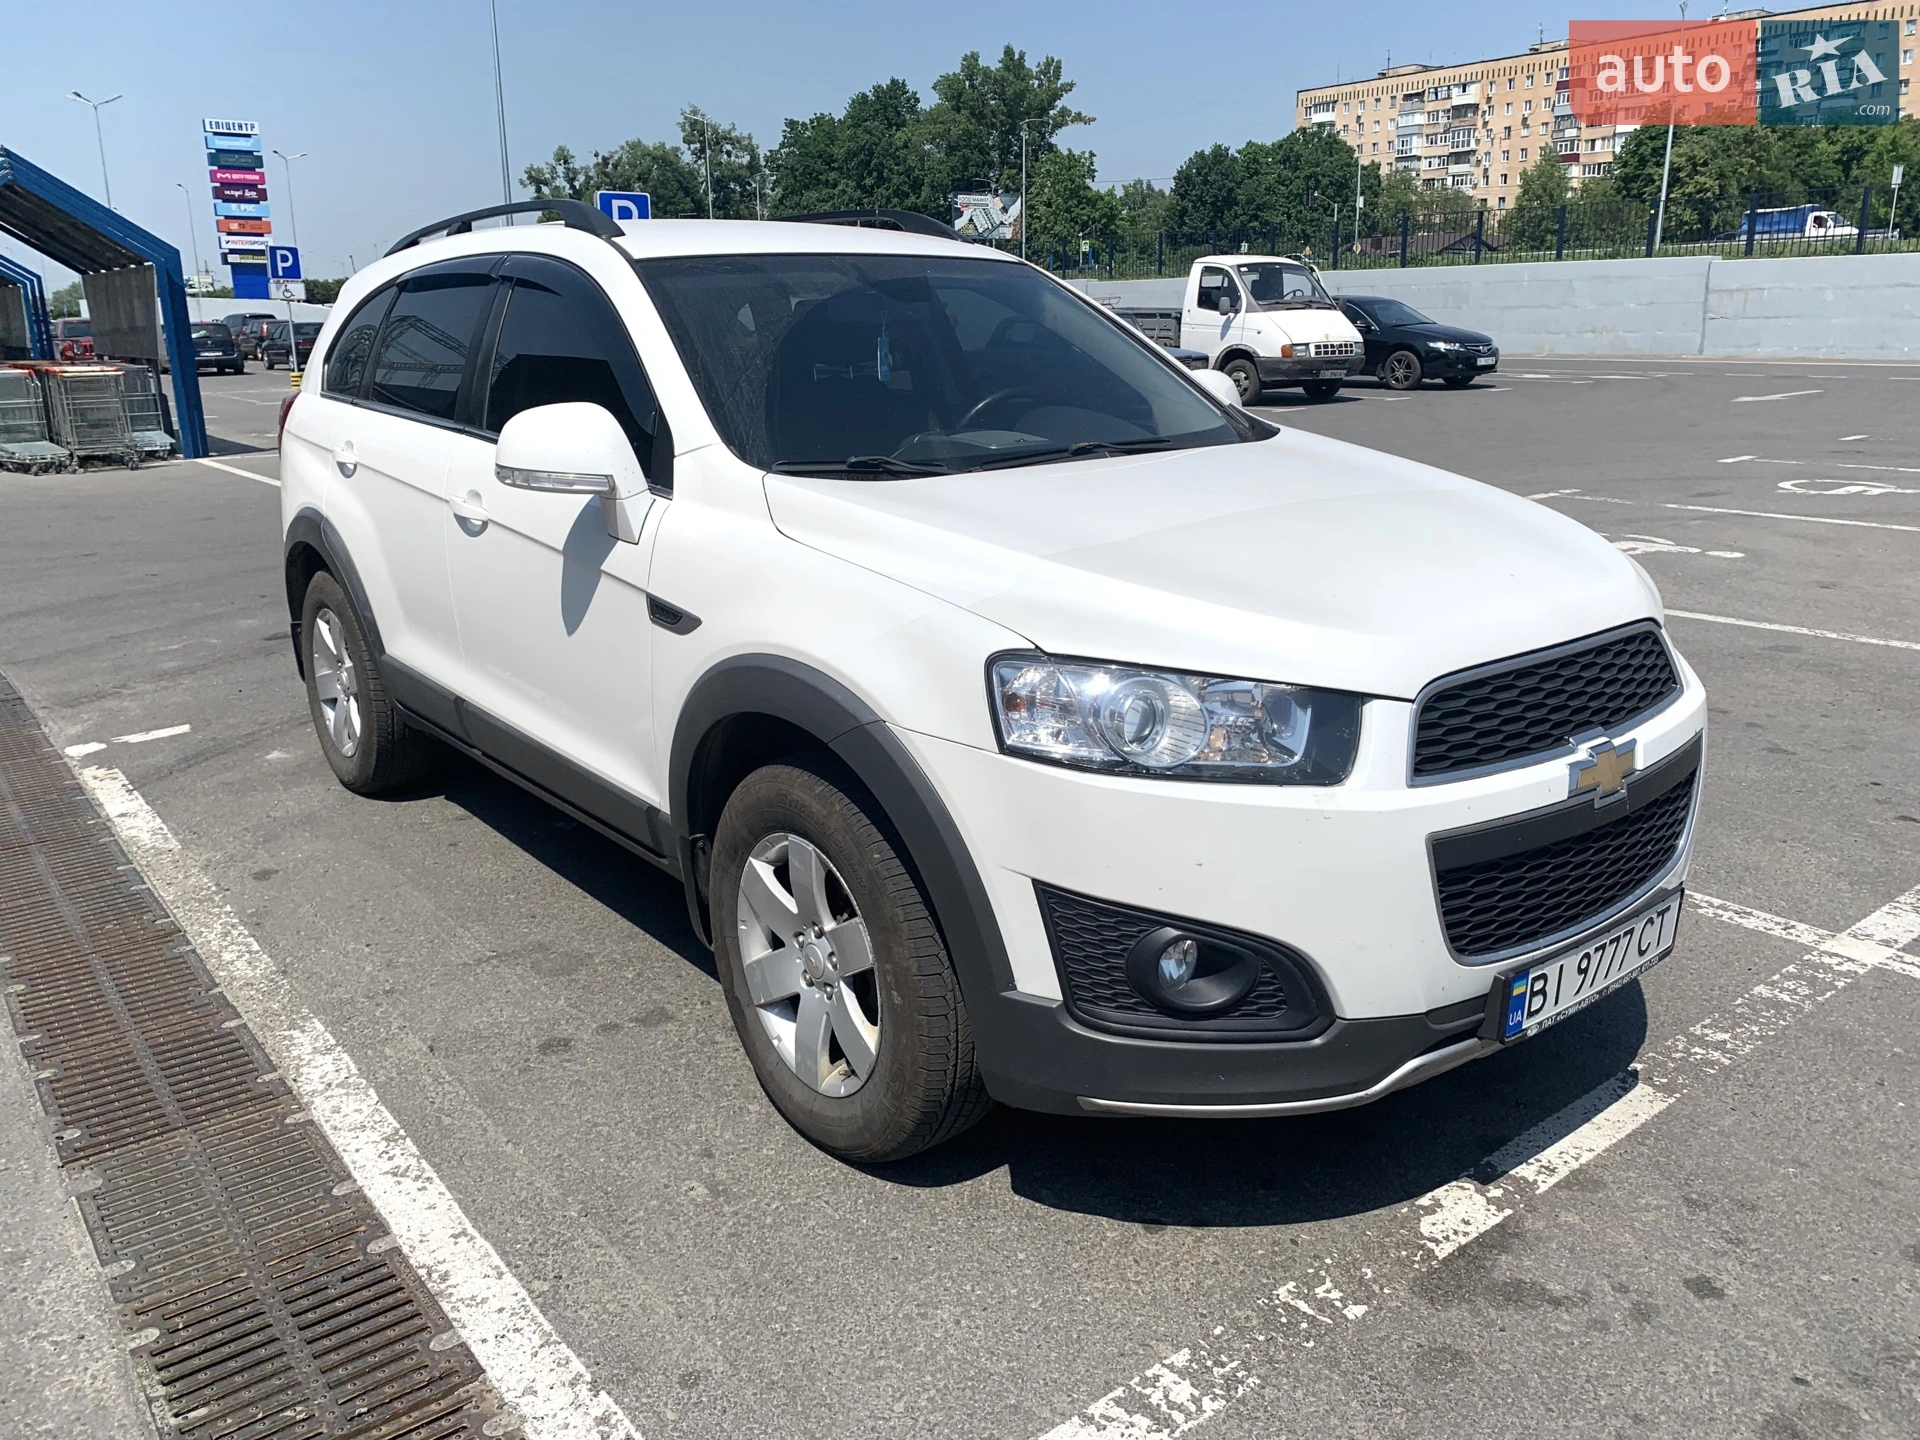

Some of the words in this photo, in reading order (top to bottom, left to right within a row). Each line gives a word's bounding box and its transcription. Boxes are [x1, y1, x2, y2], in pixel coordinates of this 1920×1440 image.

[208, 120, 256, 132] ЕПІЦЕНТР
[275, 249, 294, 277] P
[1573, 926, 1636, 996] 9777
[1509, 1011, 1523, 1026] UA
